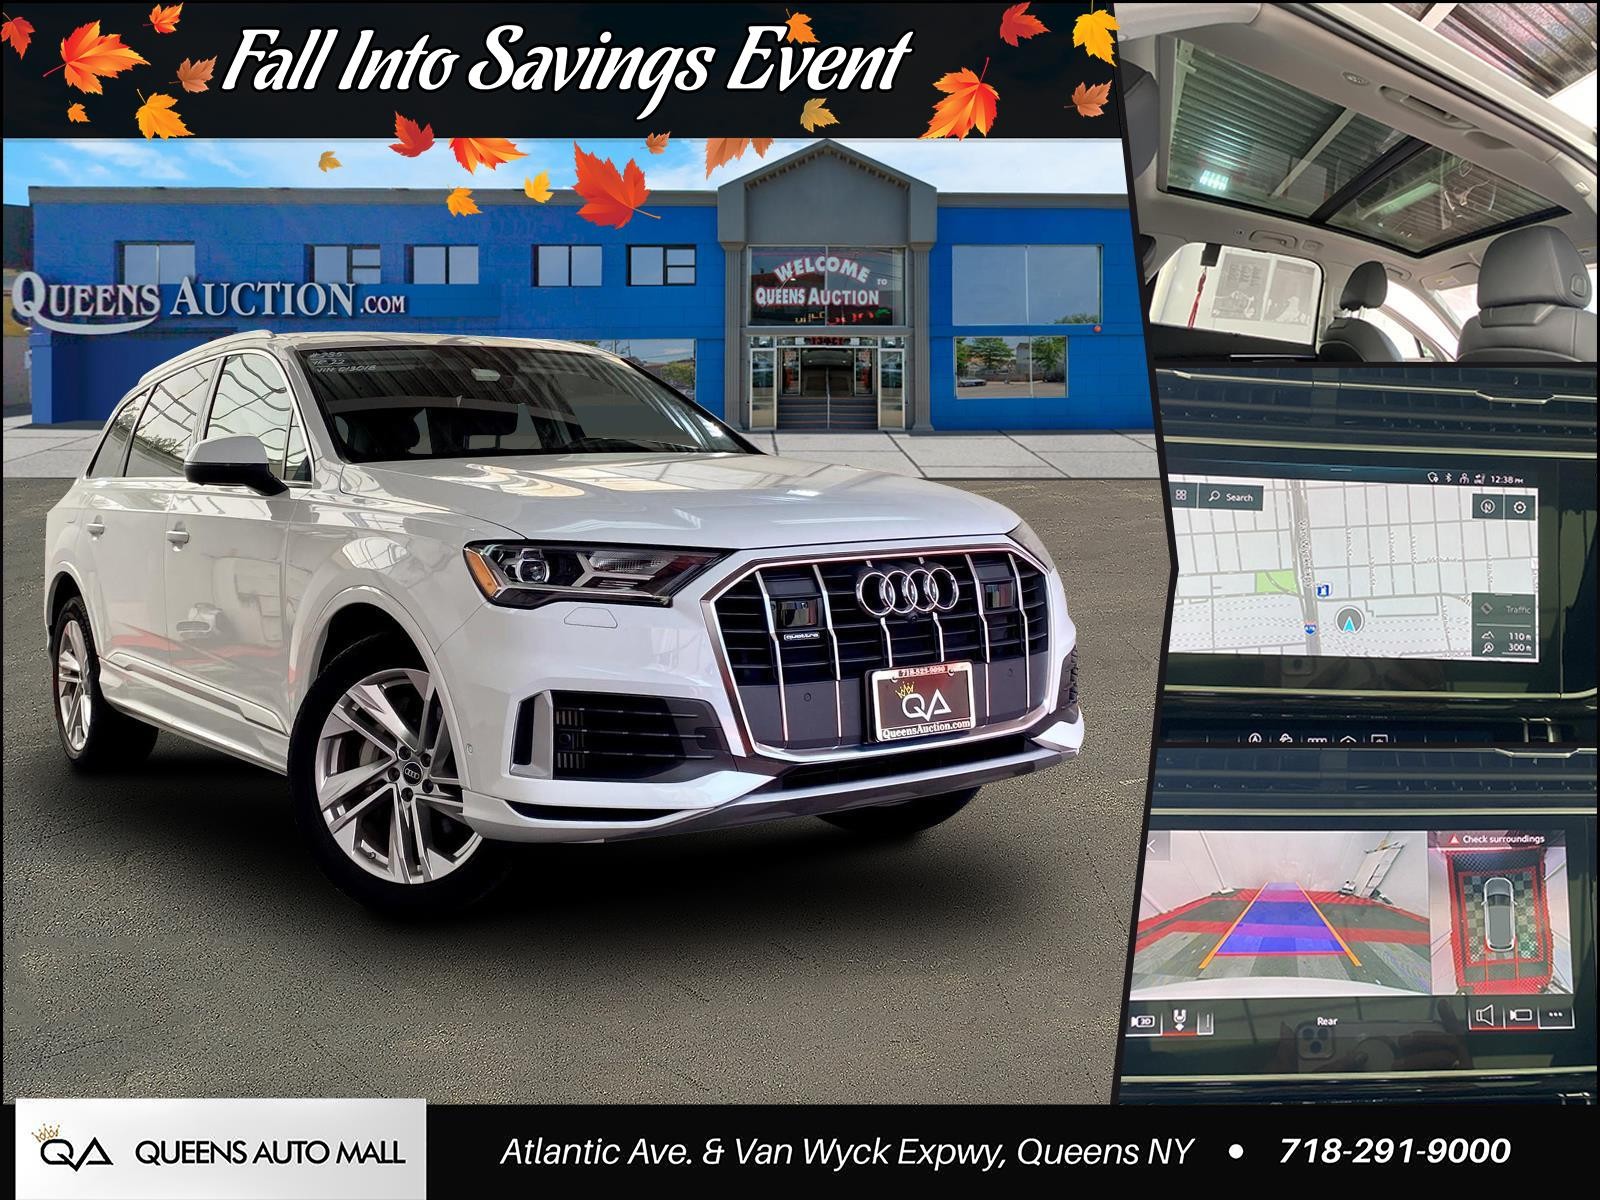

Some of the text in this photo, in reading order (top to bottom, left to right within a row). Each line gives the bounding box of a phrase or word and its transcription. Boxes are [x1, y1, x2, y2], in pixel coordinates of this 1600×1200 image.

[774, 256, 871, 283] WELCOME
[755, 286, 879, 307] QUEENS AUCTION
[11, 271, 161, 336] QUEENS
[1491, 475, 1514, 484] 12:38
[1225, 493, 1254, 502] Search
[1505, 605, 1531, 614] Traffic
[1509, 632, 1525, 641] 110
[1508, 642, 1525, 652] 300
[882, 720, 971, 740] QueensAuction.com
[1462, 834, 1545, 845] Check surroundings
[1317, 1016, 1338, 1026] Rear
